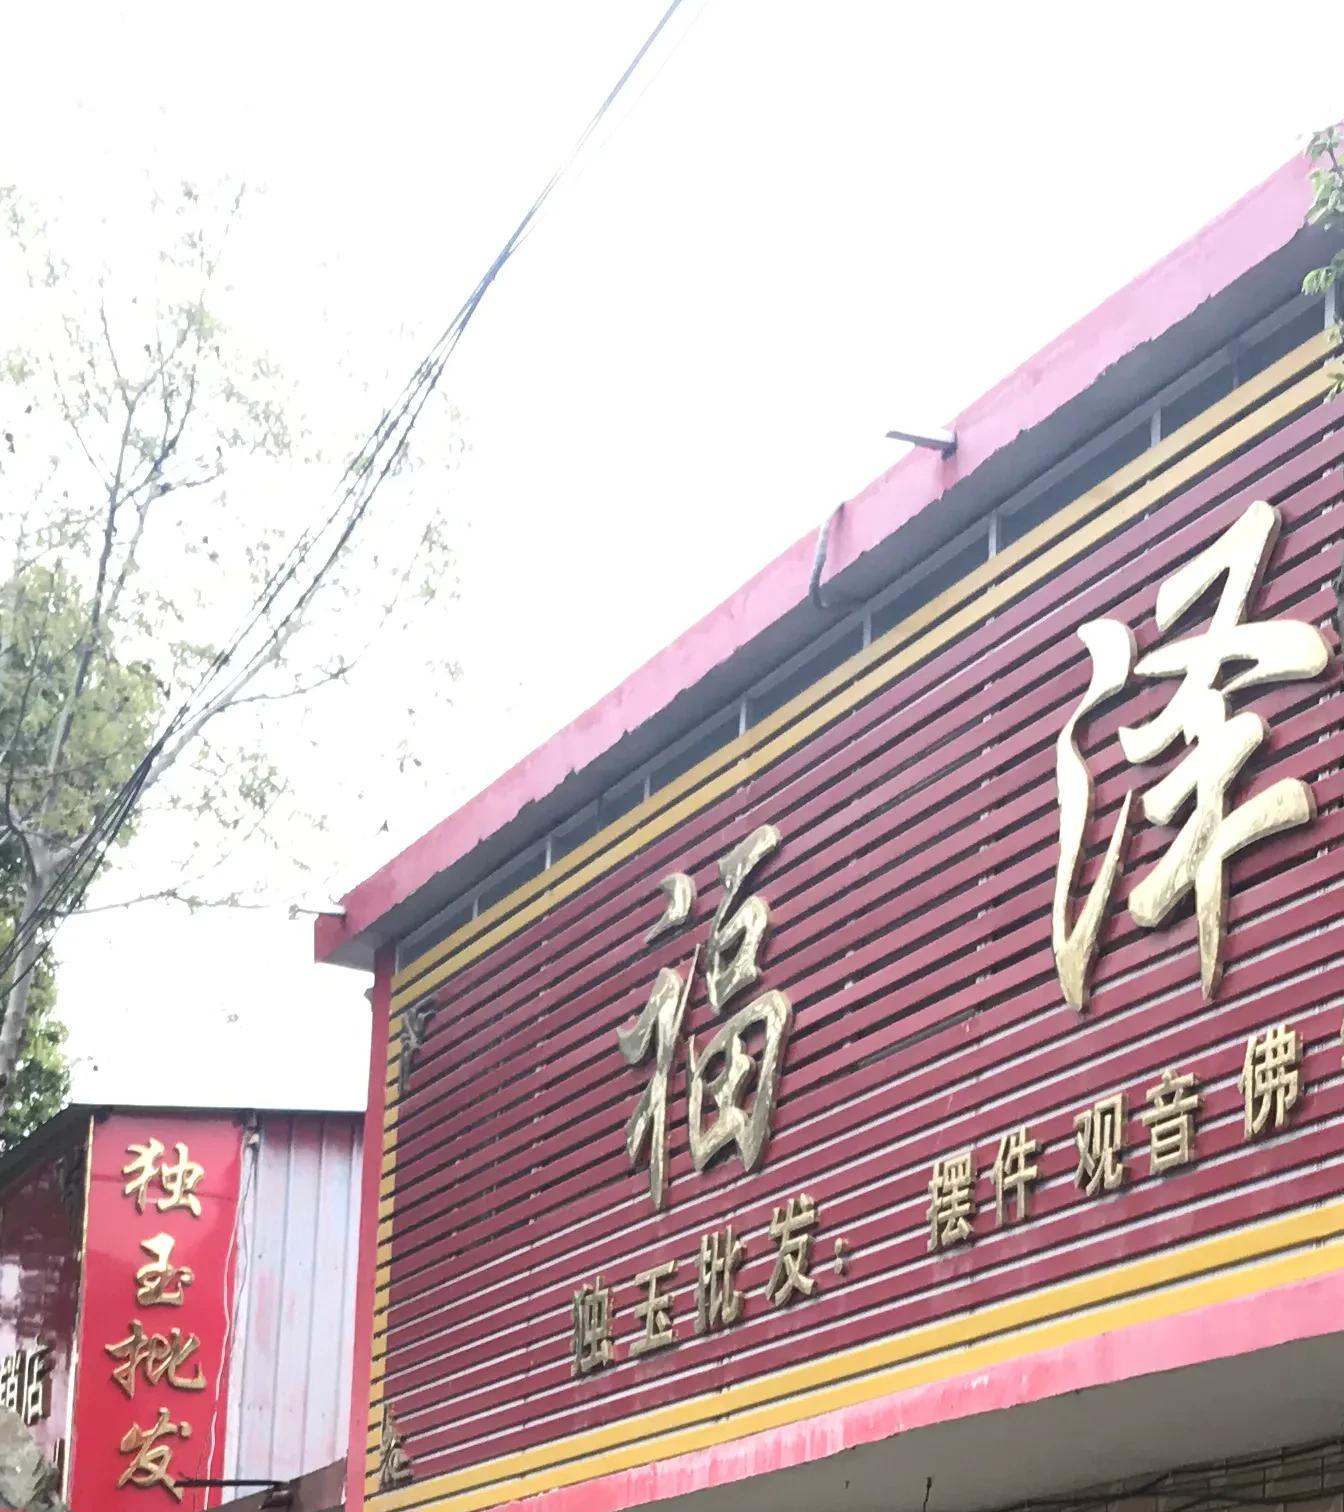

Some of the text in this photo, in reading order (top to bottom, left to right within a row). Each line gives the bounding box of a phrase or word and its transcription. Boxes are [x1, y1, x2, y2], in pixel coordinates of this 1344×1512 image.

[927, 1124, 1040, 1252] 摆件
[1072, 1068, 1201, 1197] 观音
[1238, 1022, 1308, 1138] 佛
[105, 1138, 206, 1502] 独玉批发
